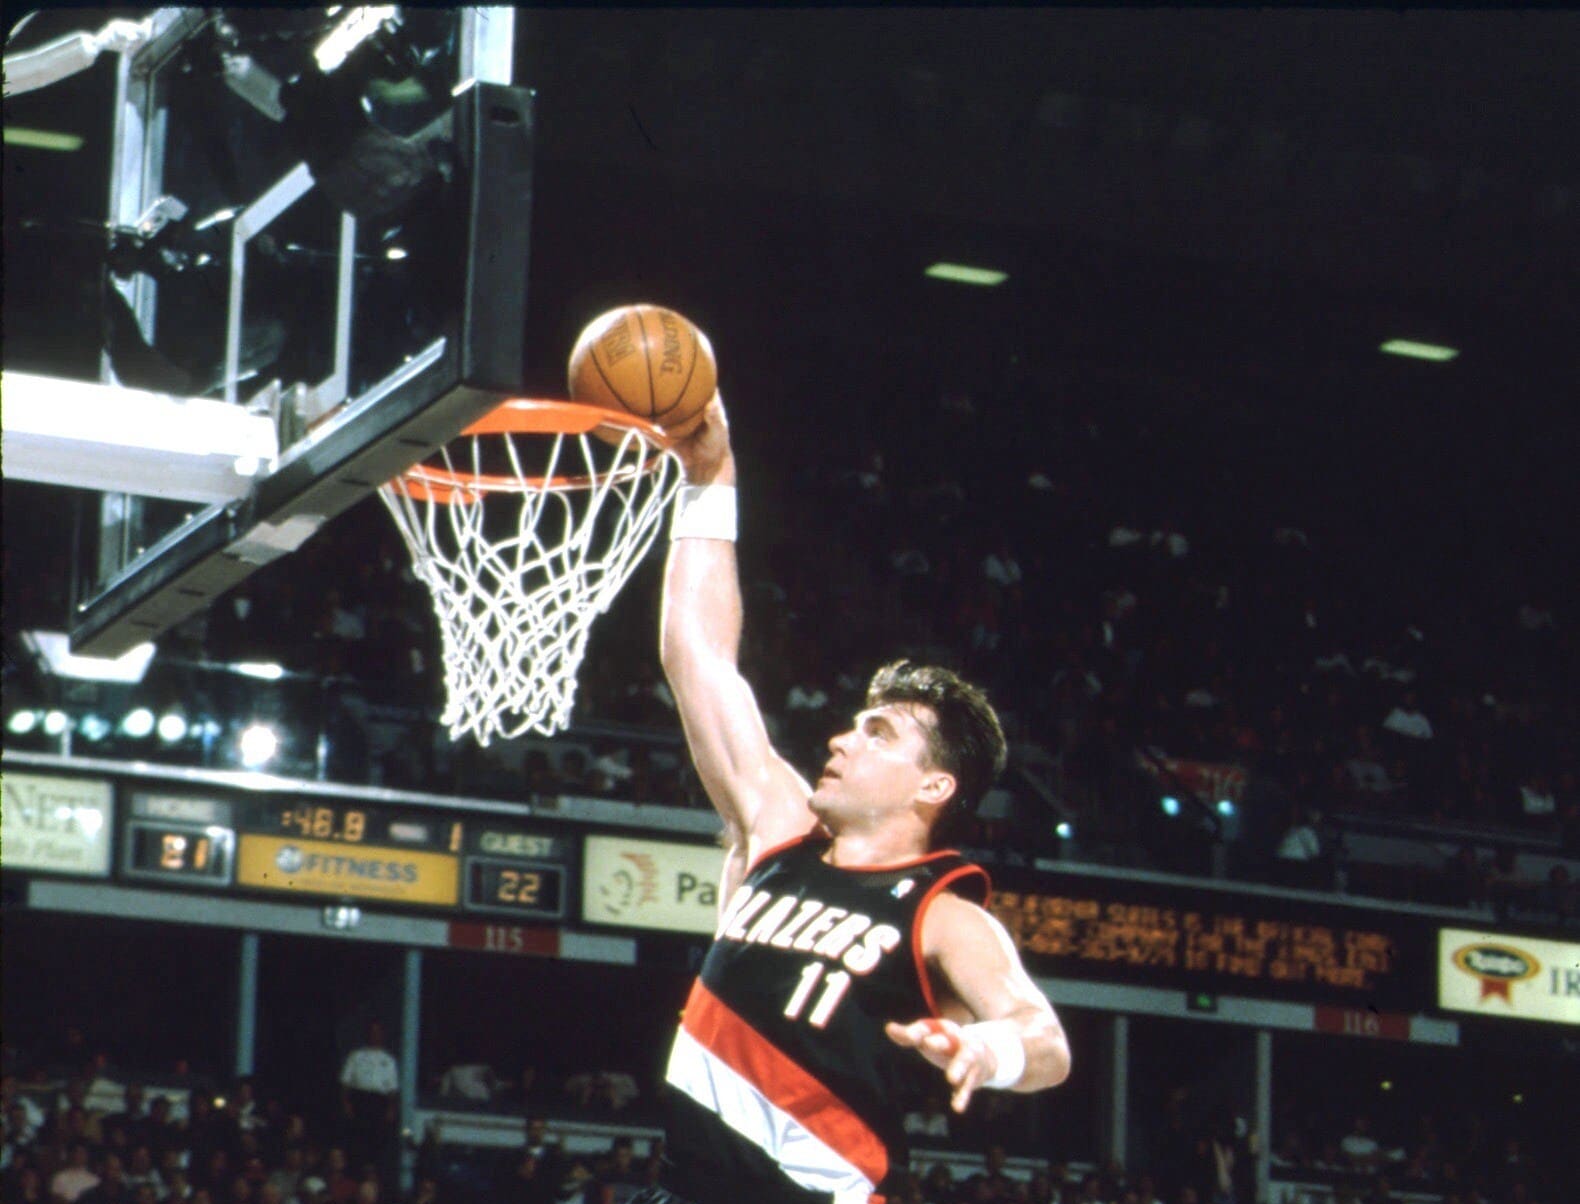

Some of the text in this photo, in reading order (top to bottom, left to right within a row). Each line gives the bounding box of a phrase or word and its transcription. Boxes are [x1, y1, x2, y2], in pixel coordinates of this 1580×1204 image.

[305, 853, 418, 884] FITNESS
[498, 869, 541, 903] 22
[484, 925, 524, 953] 115
[784, 961, 850, 1028] 11
